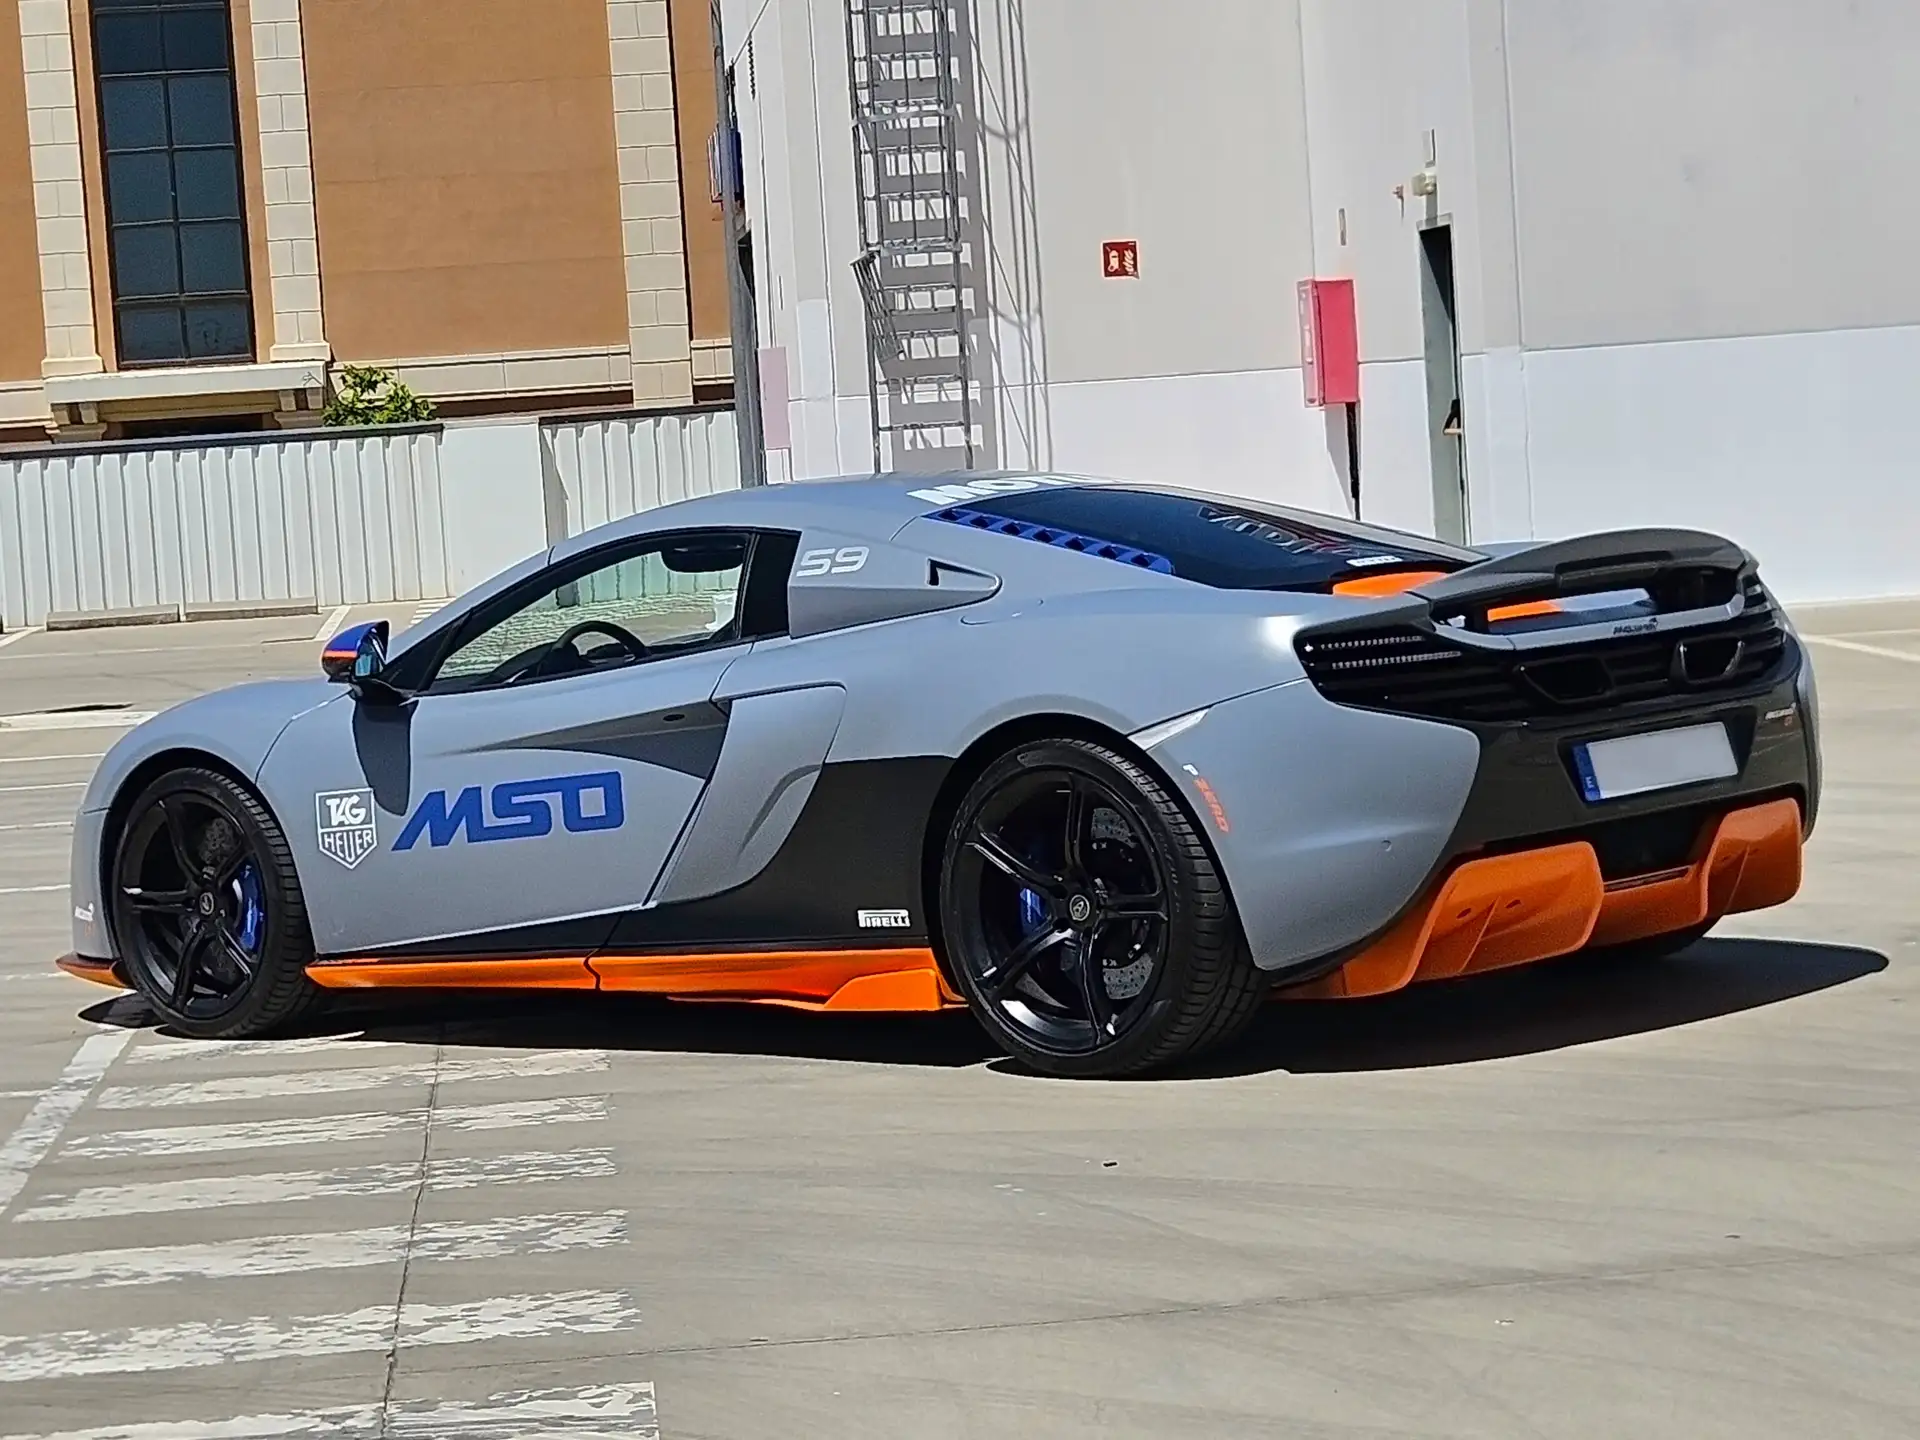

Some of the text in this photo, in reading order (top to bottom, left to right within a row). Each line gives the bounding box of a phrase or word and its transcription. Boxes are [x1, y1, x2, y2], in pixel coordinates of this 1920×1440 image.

[796, 546, 870, 577] 59
[325, 794, 367, 826] TAG
[391, 771, 625, 851] MSO
[323, 829, 373, 862] HEUER
[857, 909, 911, 928] PIRELLI
